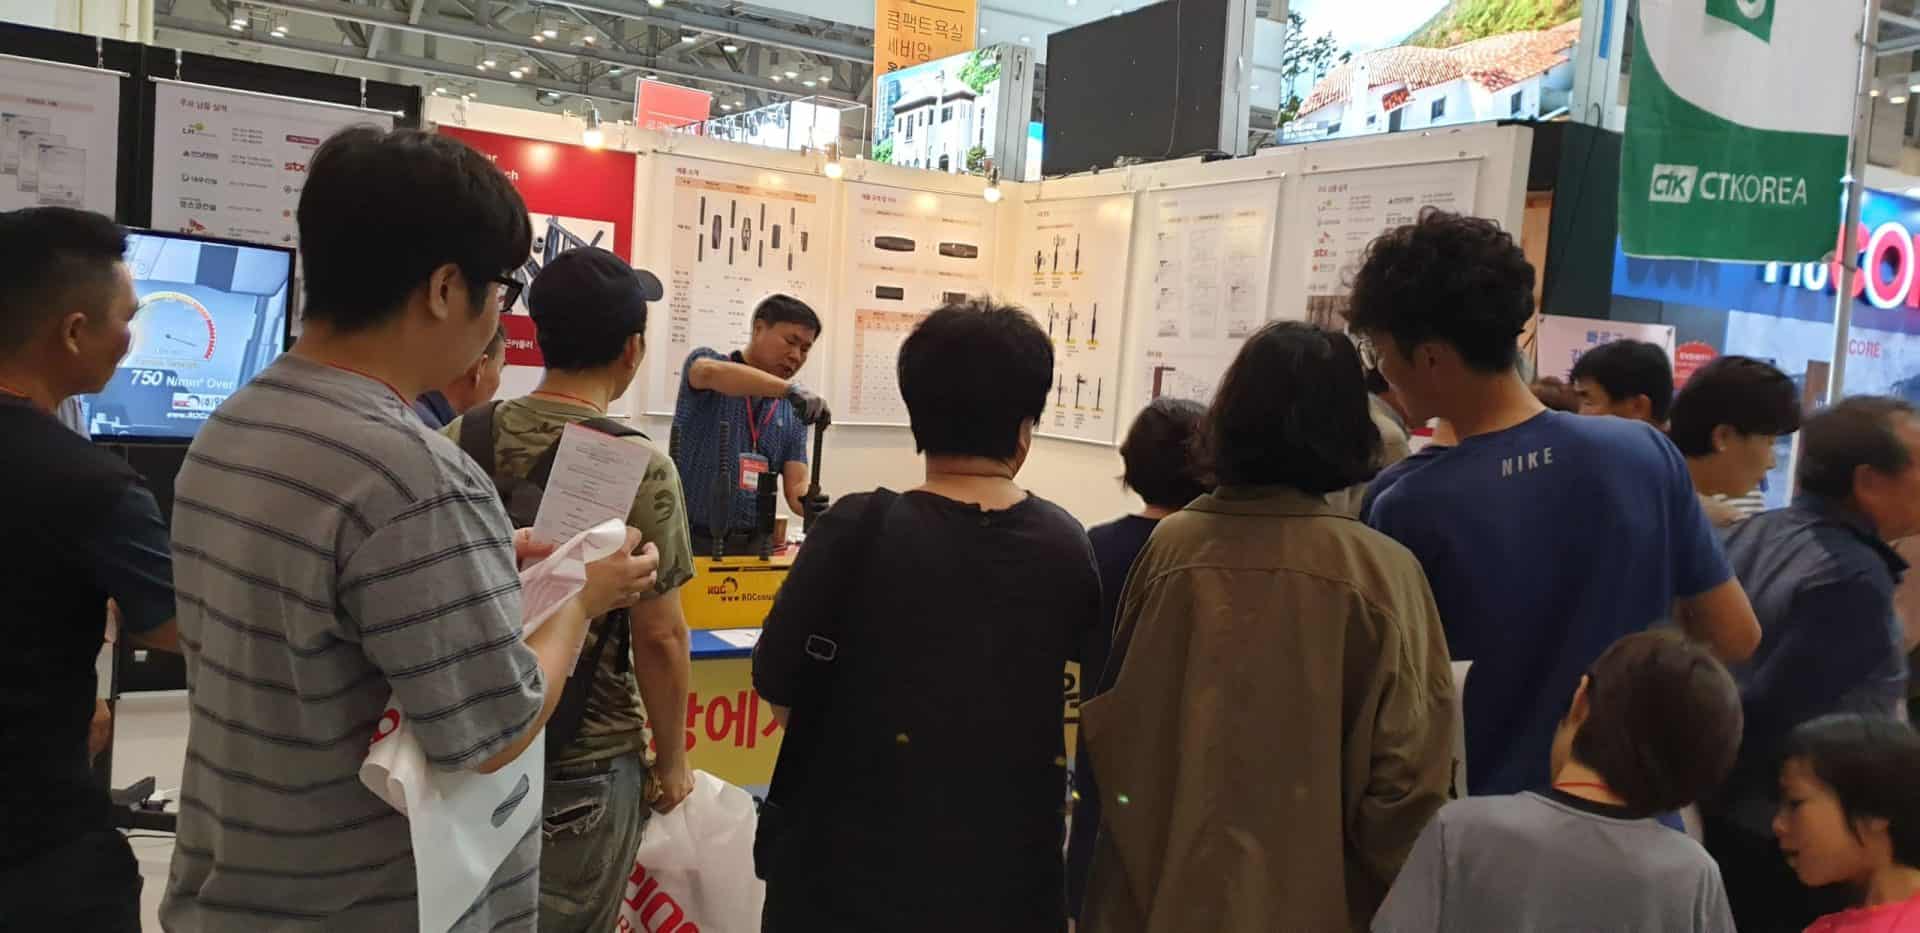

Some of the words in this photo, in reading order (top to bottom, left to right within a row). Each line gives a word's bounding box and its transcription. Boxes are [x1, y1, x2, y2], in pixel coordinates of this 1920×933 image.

[1700, 171, 1808, 206] CTKOREA
[131, 369, 163, 386] 750
[1502, 447, 1553, 477] NIKE
